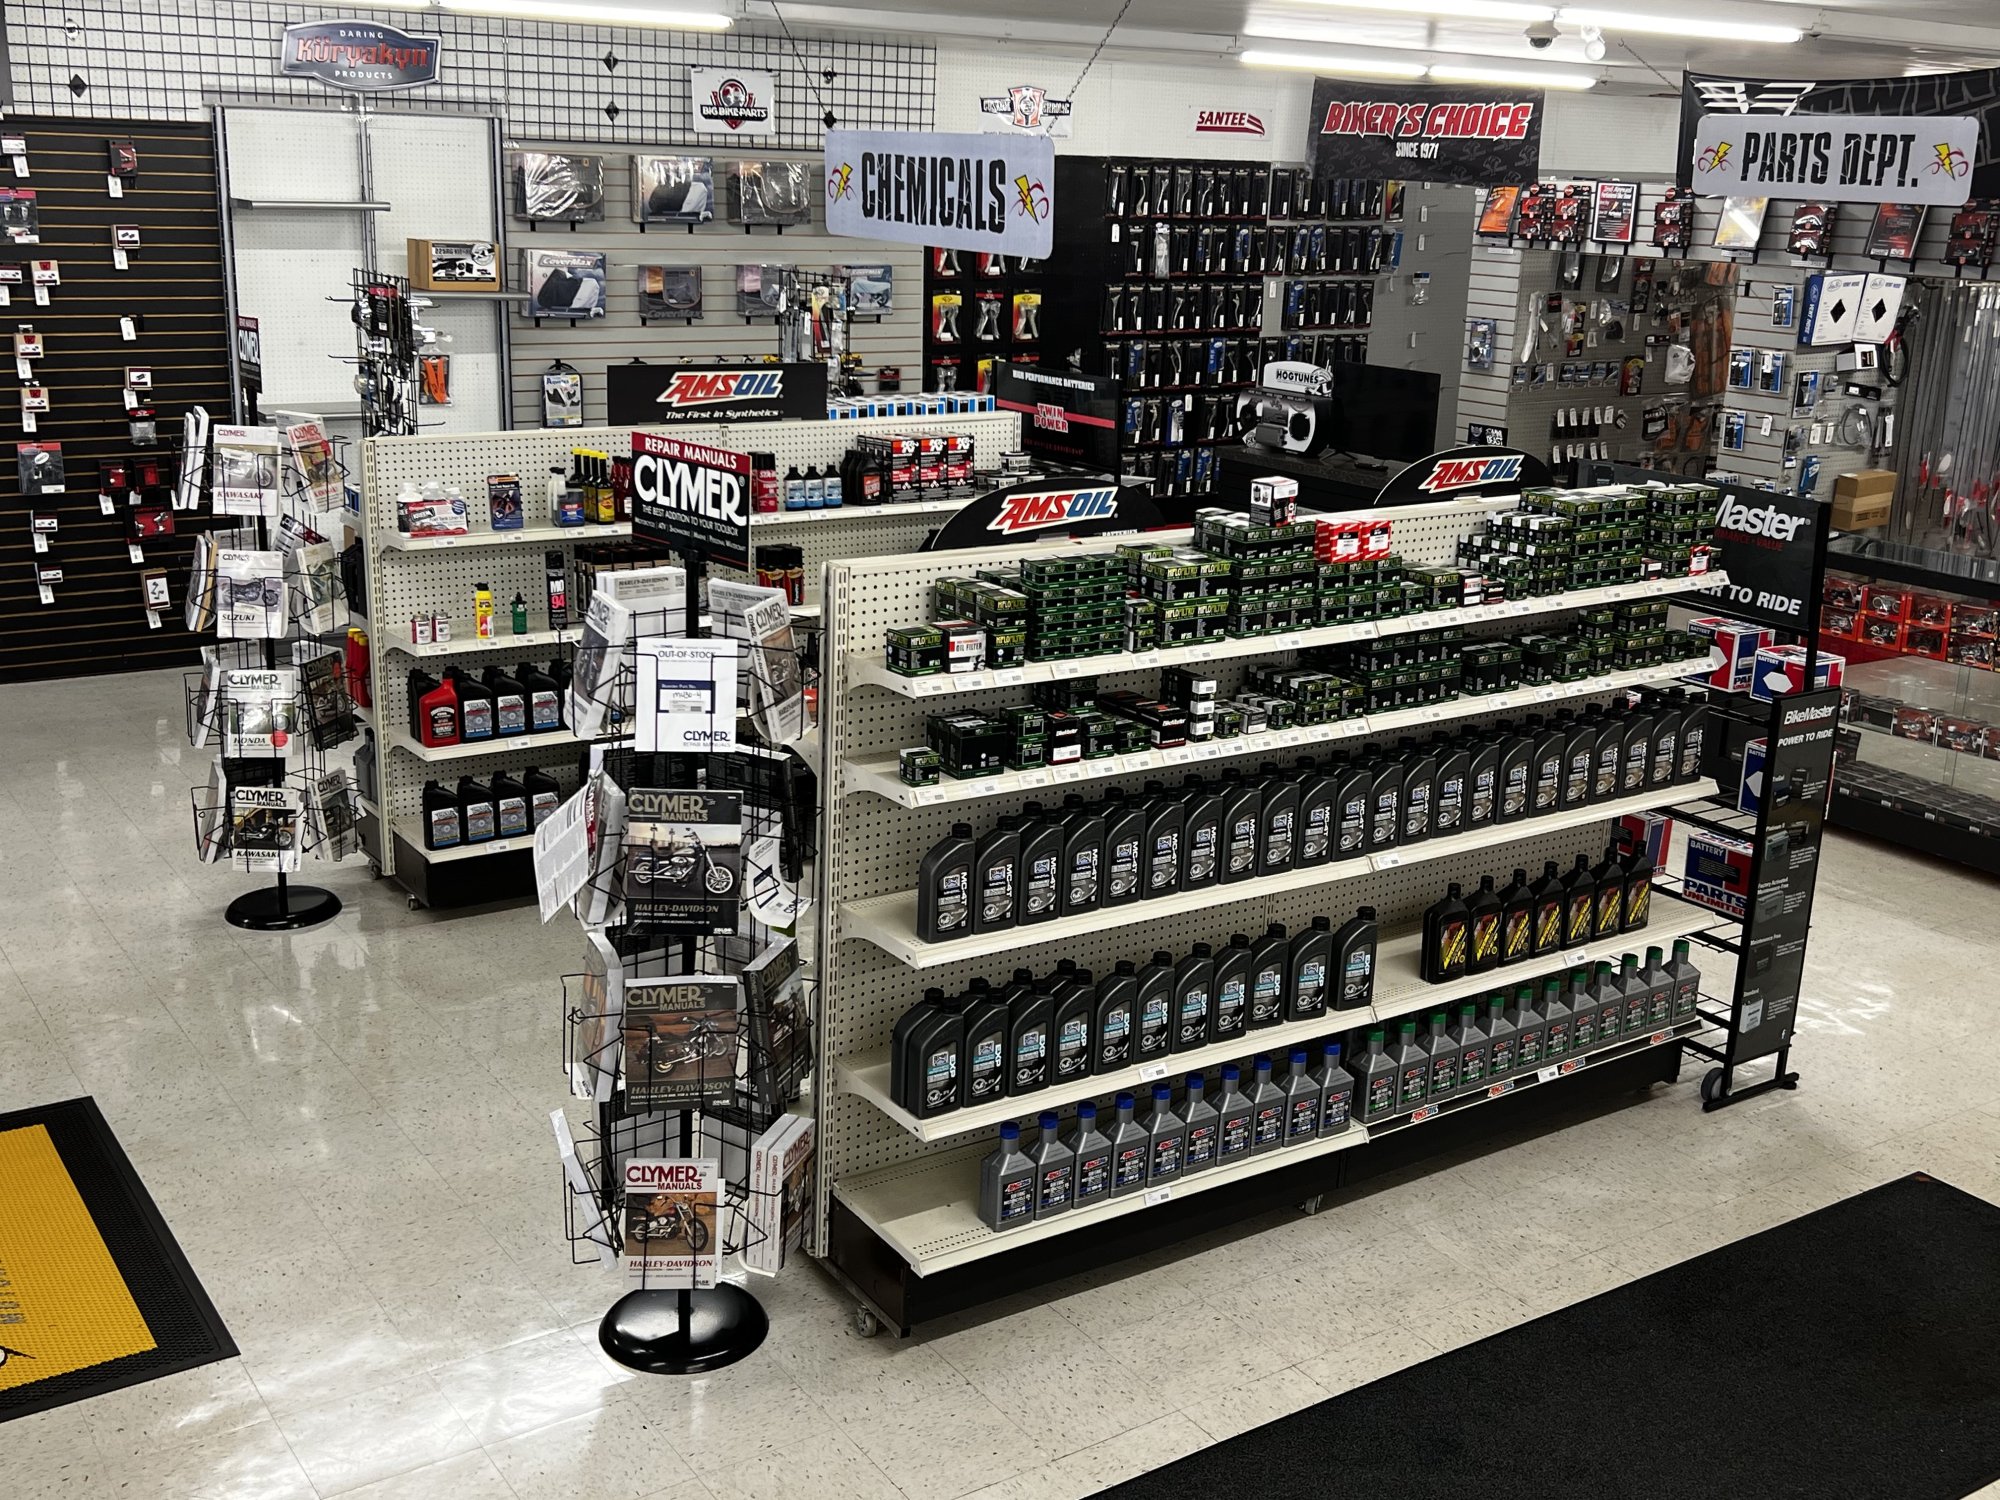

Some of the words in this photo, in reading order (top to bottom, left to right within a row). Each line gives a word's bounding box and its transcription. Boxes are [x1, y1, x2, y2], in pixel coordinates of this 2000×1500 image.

[339, 29, 384, 39] DARING
[296, 35, 428, 70] Küryakyn
[334, 70, 393, 80] PRODUCTS
[702, 106, 718, 117] BIG
[739, 108, 768, 118] PARTS
[1198, 111, 1247, 126] SANTEE
[1321, 100, 1425, 141] BIKER'S
[1423, 102, 1534, 141] CHOICE
[1396, 142, 1419, 157] SINCE
[1420, 143, 1440, 159] 1971
[1740, 132, 1832, 185] PARTS
[1839, 133, 1918, 188] DEPT.
[862, 152, 1006, 234] CHEMICALS
[540, 257, 594, 267] CoverMax
[1025, 371, 1062, 386] PERFORMANCE
[1063, 378, 1095, 391] BATTERIES
[1276, 369, 1319, 384] HOGTUNES
[657, 370, 783, 407] AMSOIL
[666, 411, 685, 419] The
[687, 410, 711, 419] First
[713, 410, 723, 418] in
[726, 409, 779, 419] Synthetics
[1037, 403, 1065, 420] TWIN
[1034, 415, 1068, 433] POWER
[217, 429, 247, 438] CLYMER
[645, 437, 681, 457] REPAIR
[684, 445, 737, 470] MANUALS
[1418, 455, 1525, 493] AMSOIL
[634, 454, 747, 527] CLYMER
[987, 486, 1118, 535] AMSOIL
[642, 504, 653, 515] THE
[653, 507, 665, 517] BEST
[665, 510, 690, 524] ADDITION
[690, 516, 699, 526] TO
[699, 518, 714, 530] YOUR
[714, 523, 739, 537] TOOLBOX
[550, 579, 565, 592] MO
[618, 576, 670, 587] HARLEY-DAVIDSON
[551, 596, 565, 609] 94
[1729, 585, 1753, 604] TO
[1756, 591, 1803, 616] RIDE
[222, 613, 256, 622] SUZUKI
[755, 602, 786, 629] CLYMER
[1690, 625, 1711, 635] BATTERY
[658, 650, 716, 660] OUT-OF-STOCK
[956, 642, 965, 652] OIL
[966, 641, 982, 651] FILTER
[1758, 655, 1779, 665] BATTERY
[229, 672, 282, 686] CLYMER
[1784, 705, 1836, 726] BikeMaster
[233, 736, 266, 745] HONDA
[683, 730, 731, 742] CLYMER
[1778, 734, 1804, 748] POWER
[1805, 732, 1815, 743] TO
[1816, 728, 1834, 740] RIDE
[1749, 748, 1766, 758] BATTE
[235, 789, 287, 803] CLYMER
[629, 793, 709, 815] CLYMER
[661, 812, 709, 822] MANUALS
[1690, 840, 1724, 857] BATTERY
[1684, 879, 1747, 908] PARTS
[1683, 889, 1745, 916] UNLIMITED
[627, 985, 706, 1006] CLYMER
[659, 1001, 706, 1012] MANUALS
[1650, 1029, 1674, 1046] AMSOIL
[1560, 1057, 1586, 1074] AMSOIL
[1487, 1080, 1515, 1098] AMSOIL
[1410, 1104, 1439, 1123] AMSOIL
[783, 1131, 811, 1169] CLYMER
[626, 1166, 702, 1183] CLYMER
[657, 1182, 703, 1191] MANUALS
[629, 1259, 713, 1269] HARLEY-DAVIDSON
